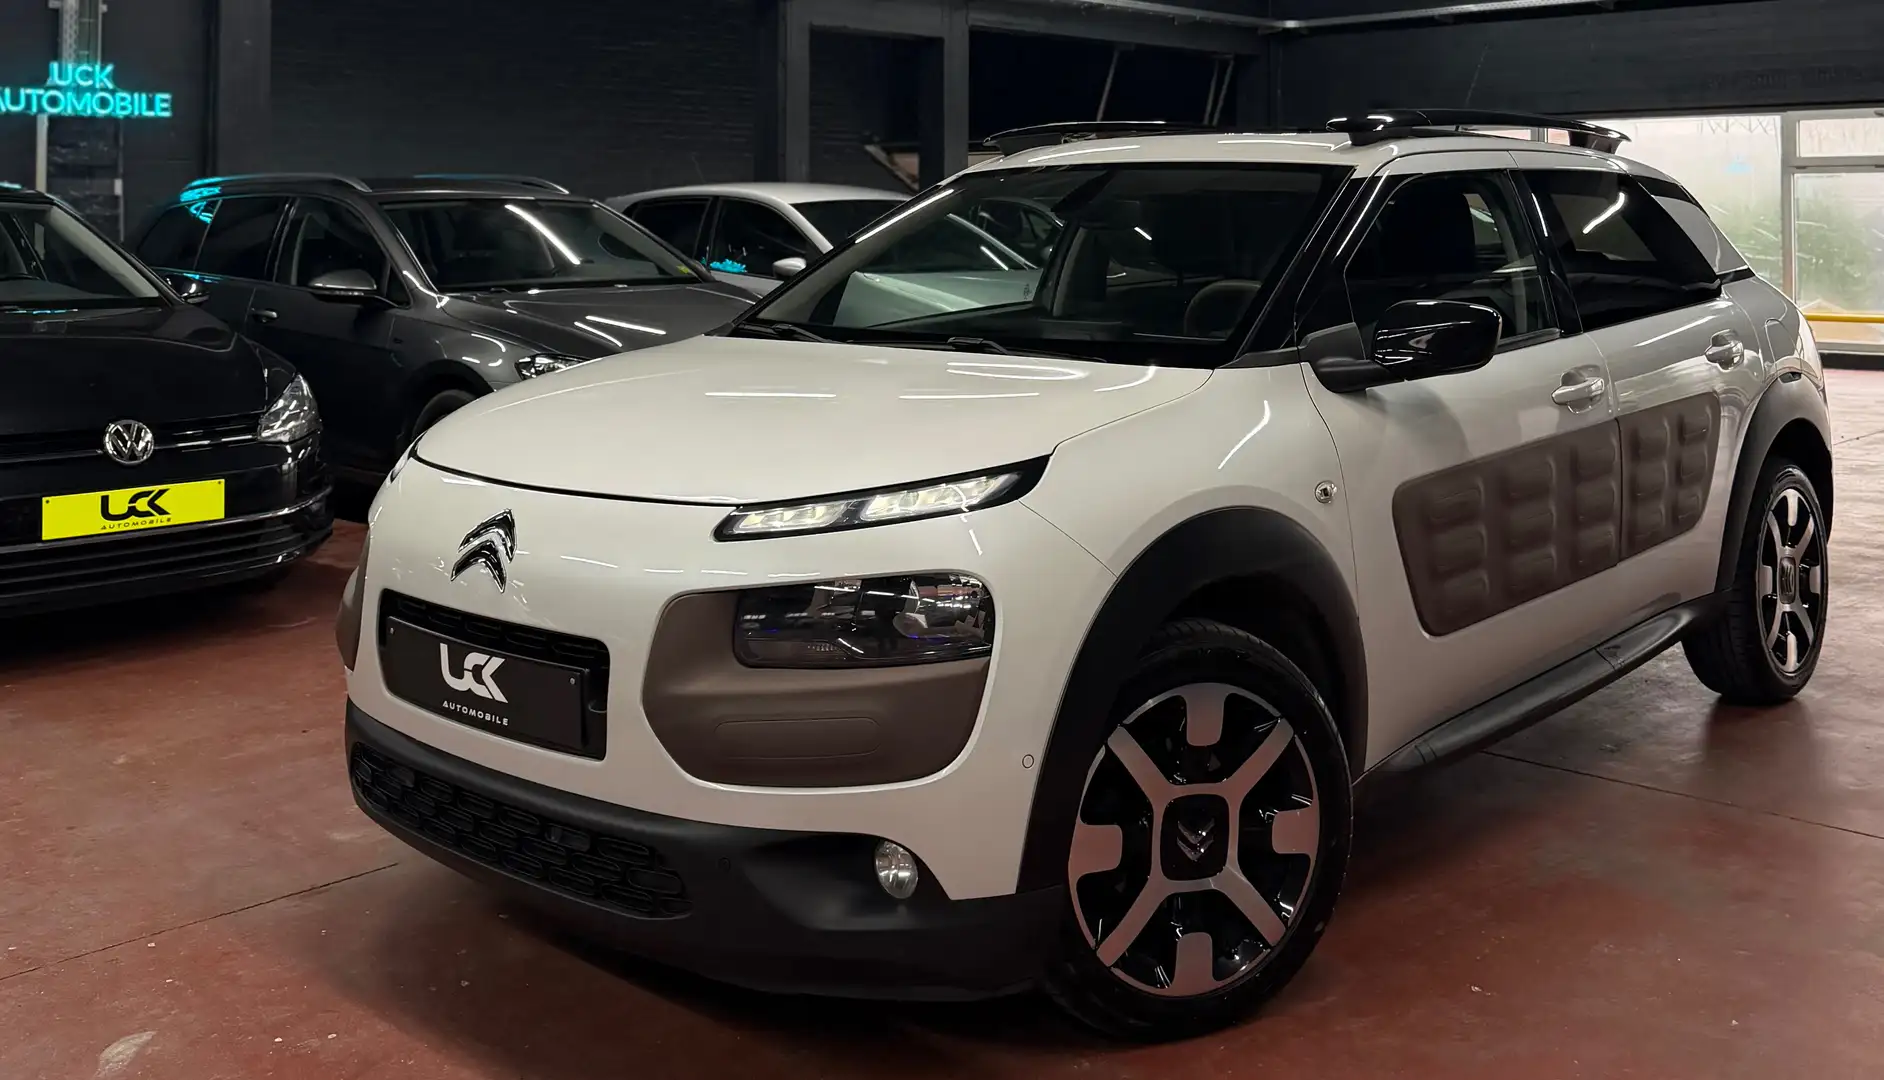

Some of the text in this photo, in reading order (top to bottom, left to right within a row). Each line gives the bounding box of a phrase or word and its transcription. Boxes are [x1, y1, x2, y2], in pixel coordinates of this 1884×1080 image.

[49, 62, 115, 90] UCK
[101, 488, 171, 521] UCK
[101, 517, 171, 529] AUTOMOBILE
[440, 643, 508, 703] UCK
[442, 700, 509, 726] AUTOMOBILE
